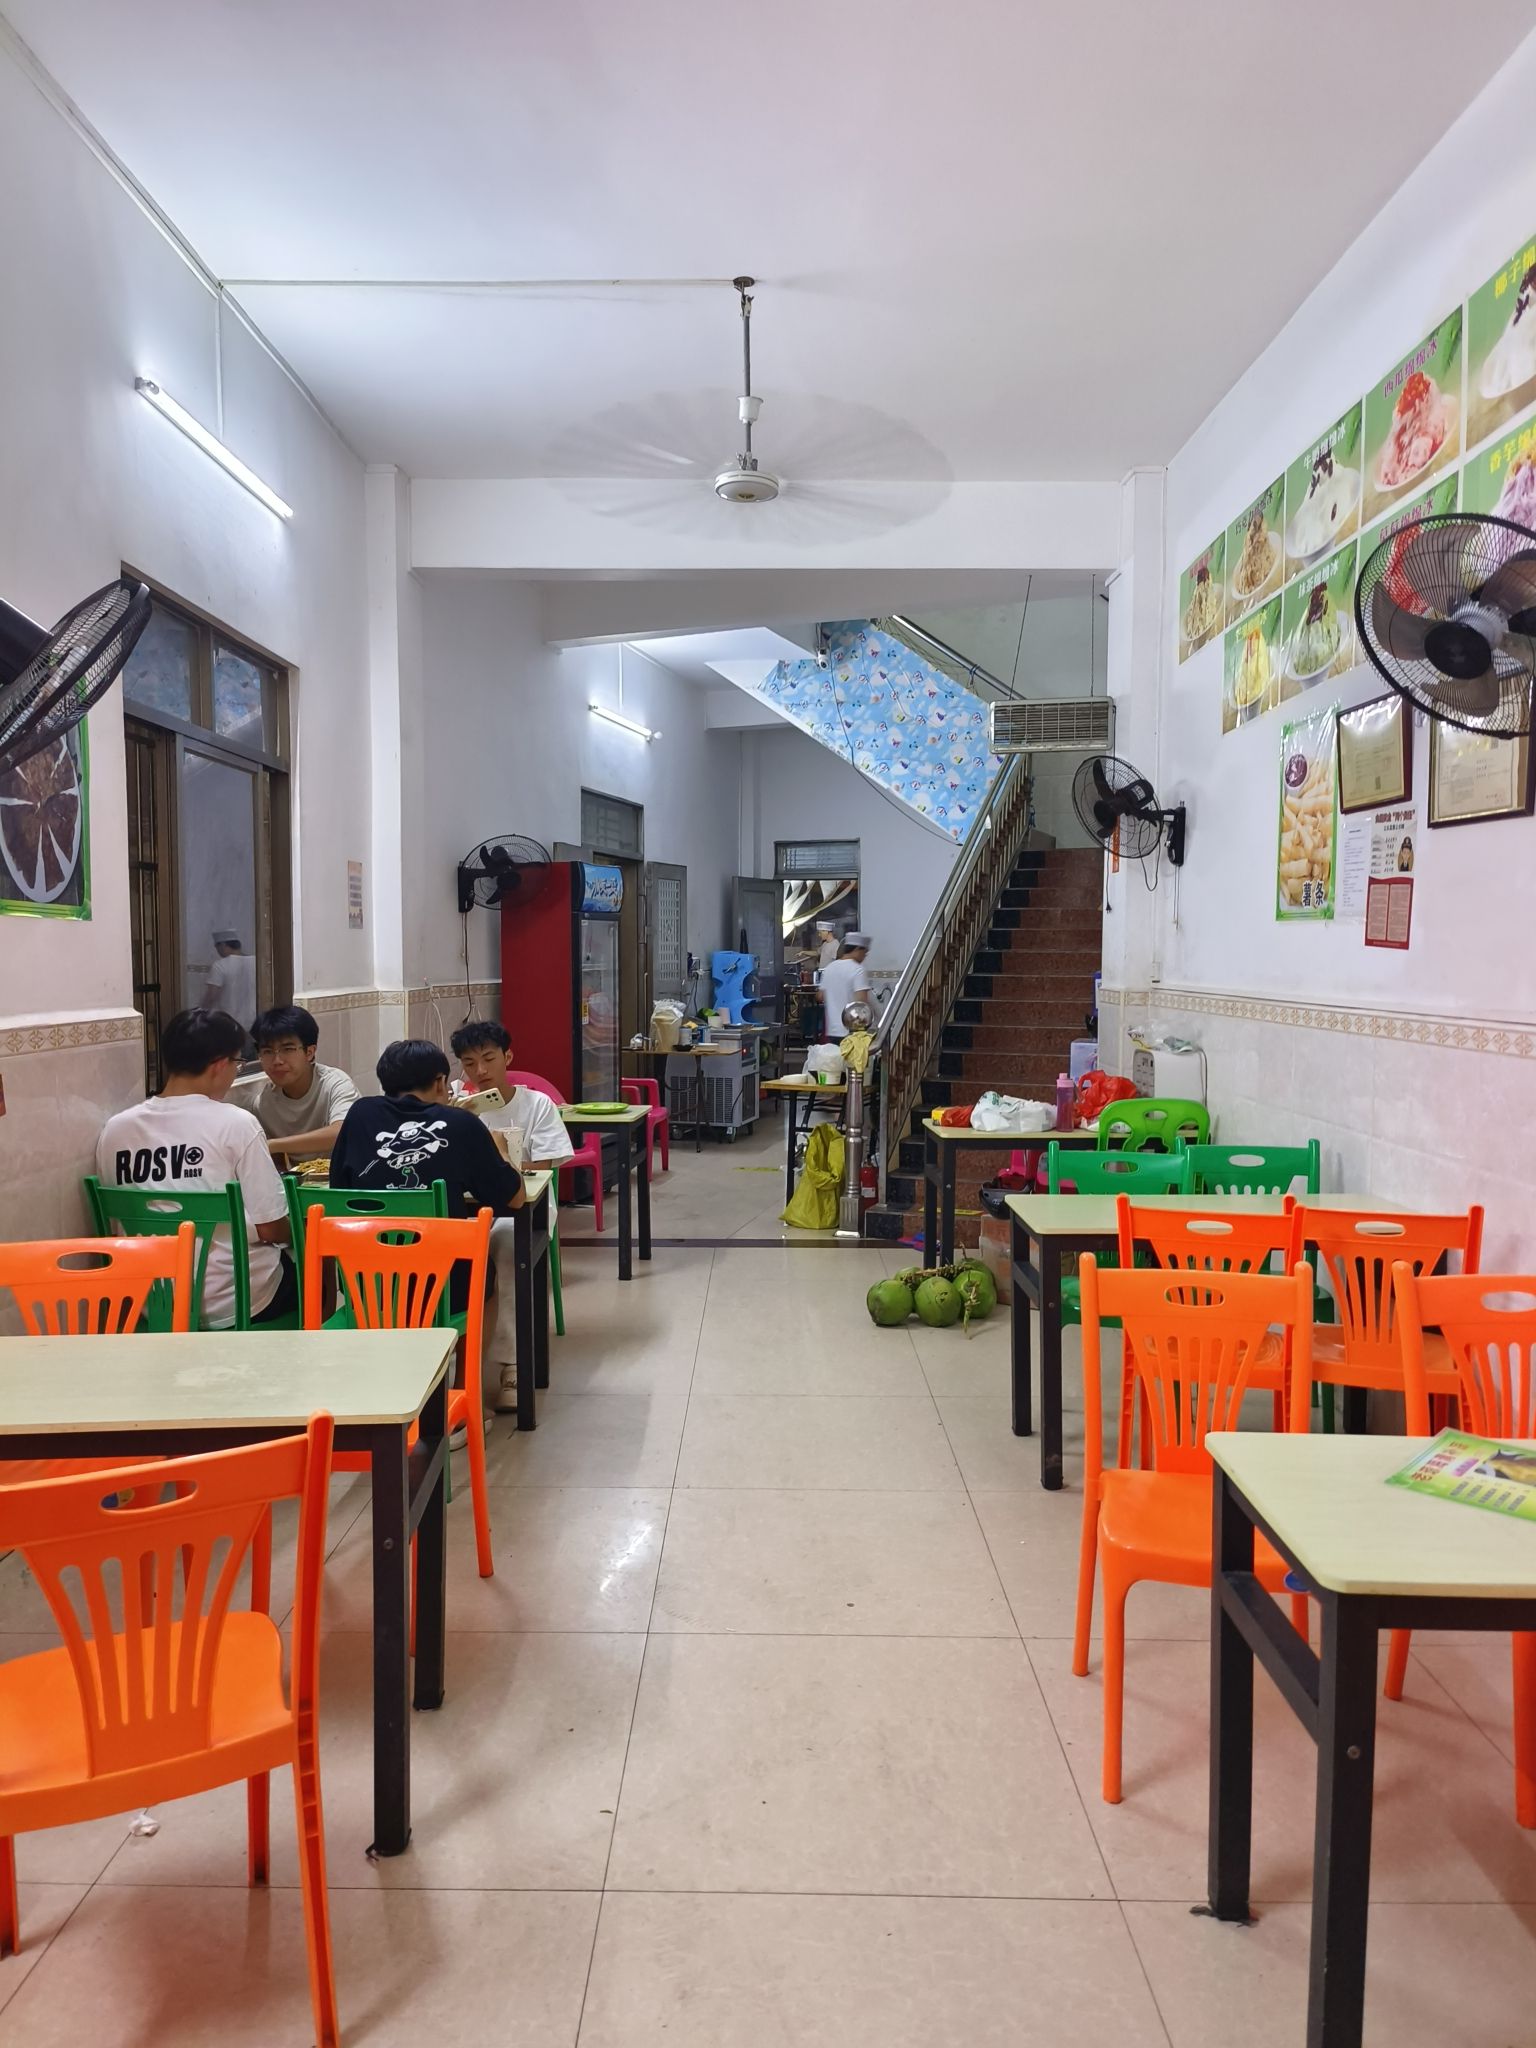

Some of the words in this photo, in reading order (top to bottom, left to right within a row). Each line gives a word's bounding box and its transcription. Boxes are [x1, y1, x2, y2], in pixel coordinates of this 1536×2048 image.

[1303, 881, 1324, 906] 薯条
[116, 1144, 187, 1186] ROSV
[184, 1168, 203, 1178] ROSV
